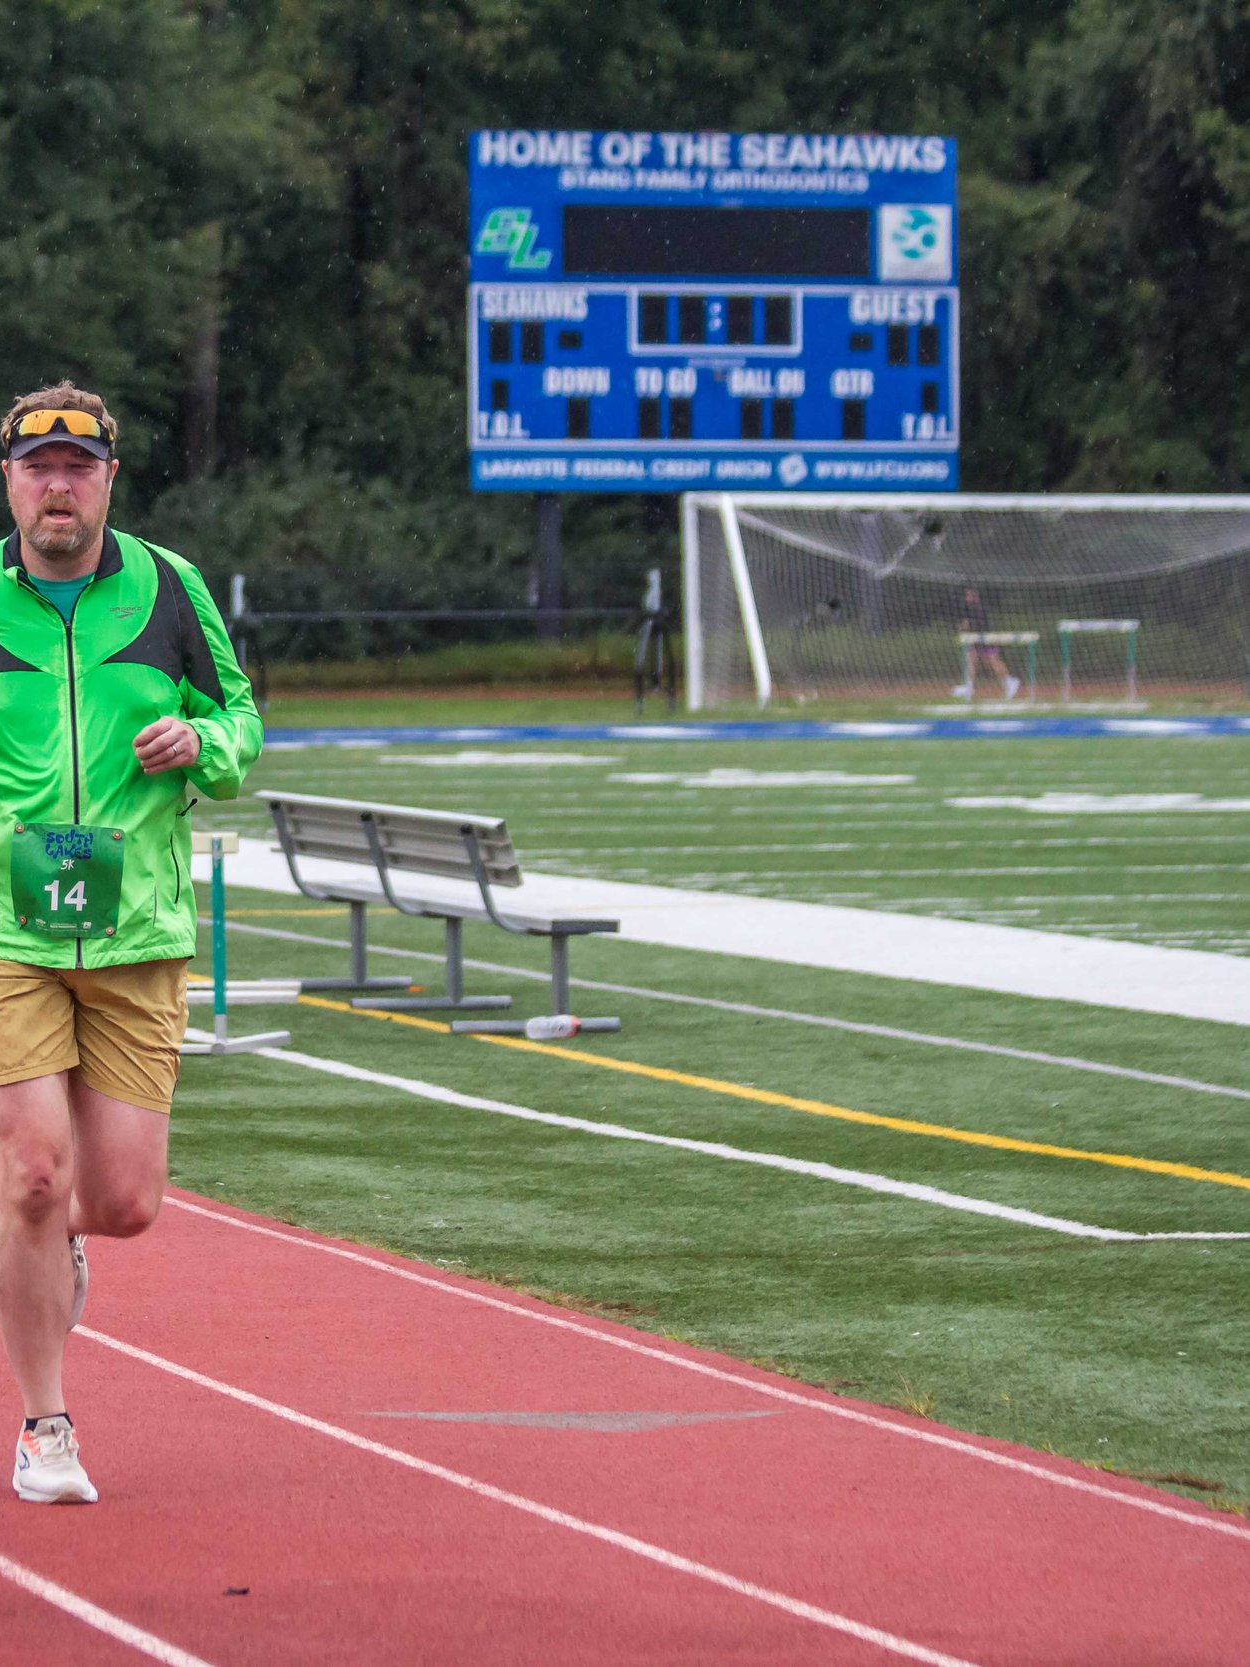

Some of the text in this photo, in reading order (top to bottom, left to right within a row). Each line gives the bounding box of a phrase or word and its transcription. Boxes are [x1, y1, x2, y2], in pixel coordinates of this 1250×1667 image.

[478, 130, 946, 172] HOME OF THE SEAHAWKS
[635, 169, 707, 190] FAMILY
[711, 170, 869, 193] ORTHODONTICS
[482, 288, 588, 319] SEAHAWKS
[850, 290, 936, 324] GUEST
[544, 367, 610, 397] DOWN
[635, 367, 697, 398] TO GO
[728, 367, 805, 398] BALL ON
[831, 368, 874, 398] QTR
[480, 458, 568, 480] LAFAYETTE
[572, 458, 646, 480] FEDERAL
[651, 459, 711, 480] CREDIT
[716, 459, 772, 480] UNION
[45, 829, 93, 848] SOUTH
[45, 844, 92, 859] LAKES
[60, 859, 74, 870] 5K
[44, 880, 87, 911] 14
